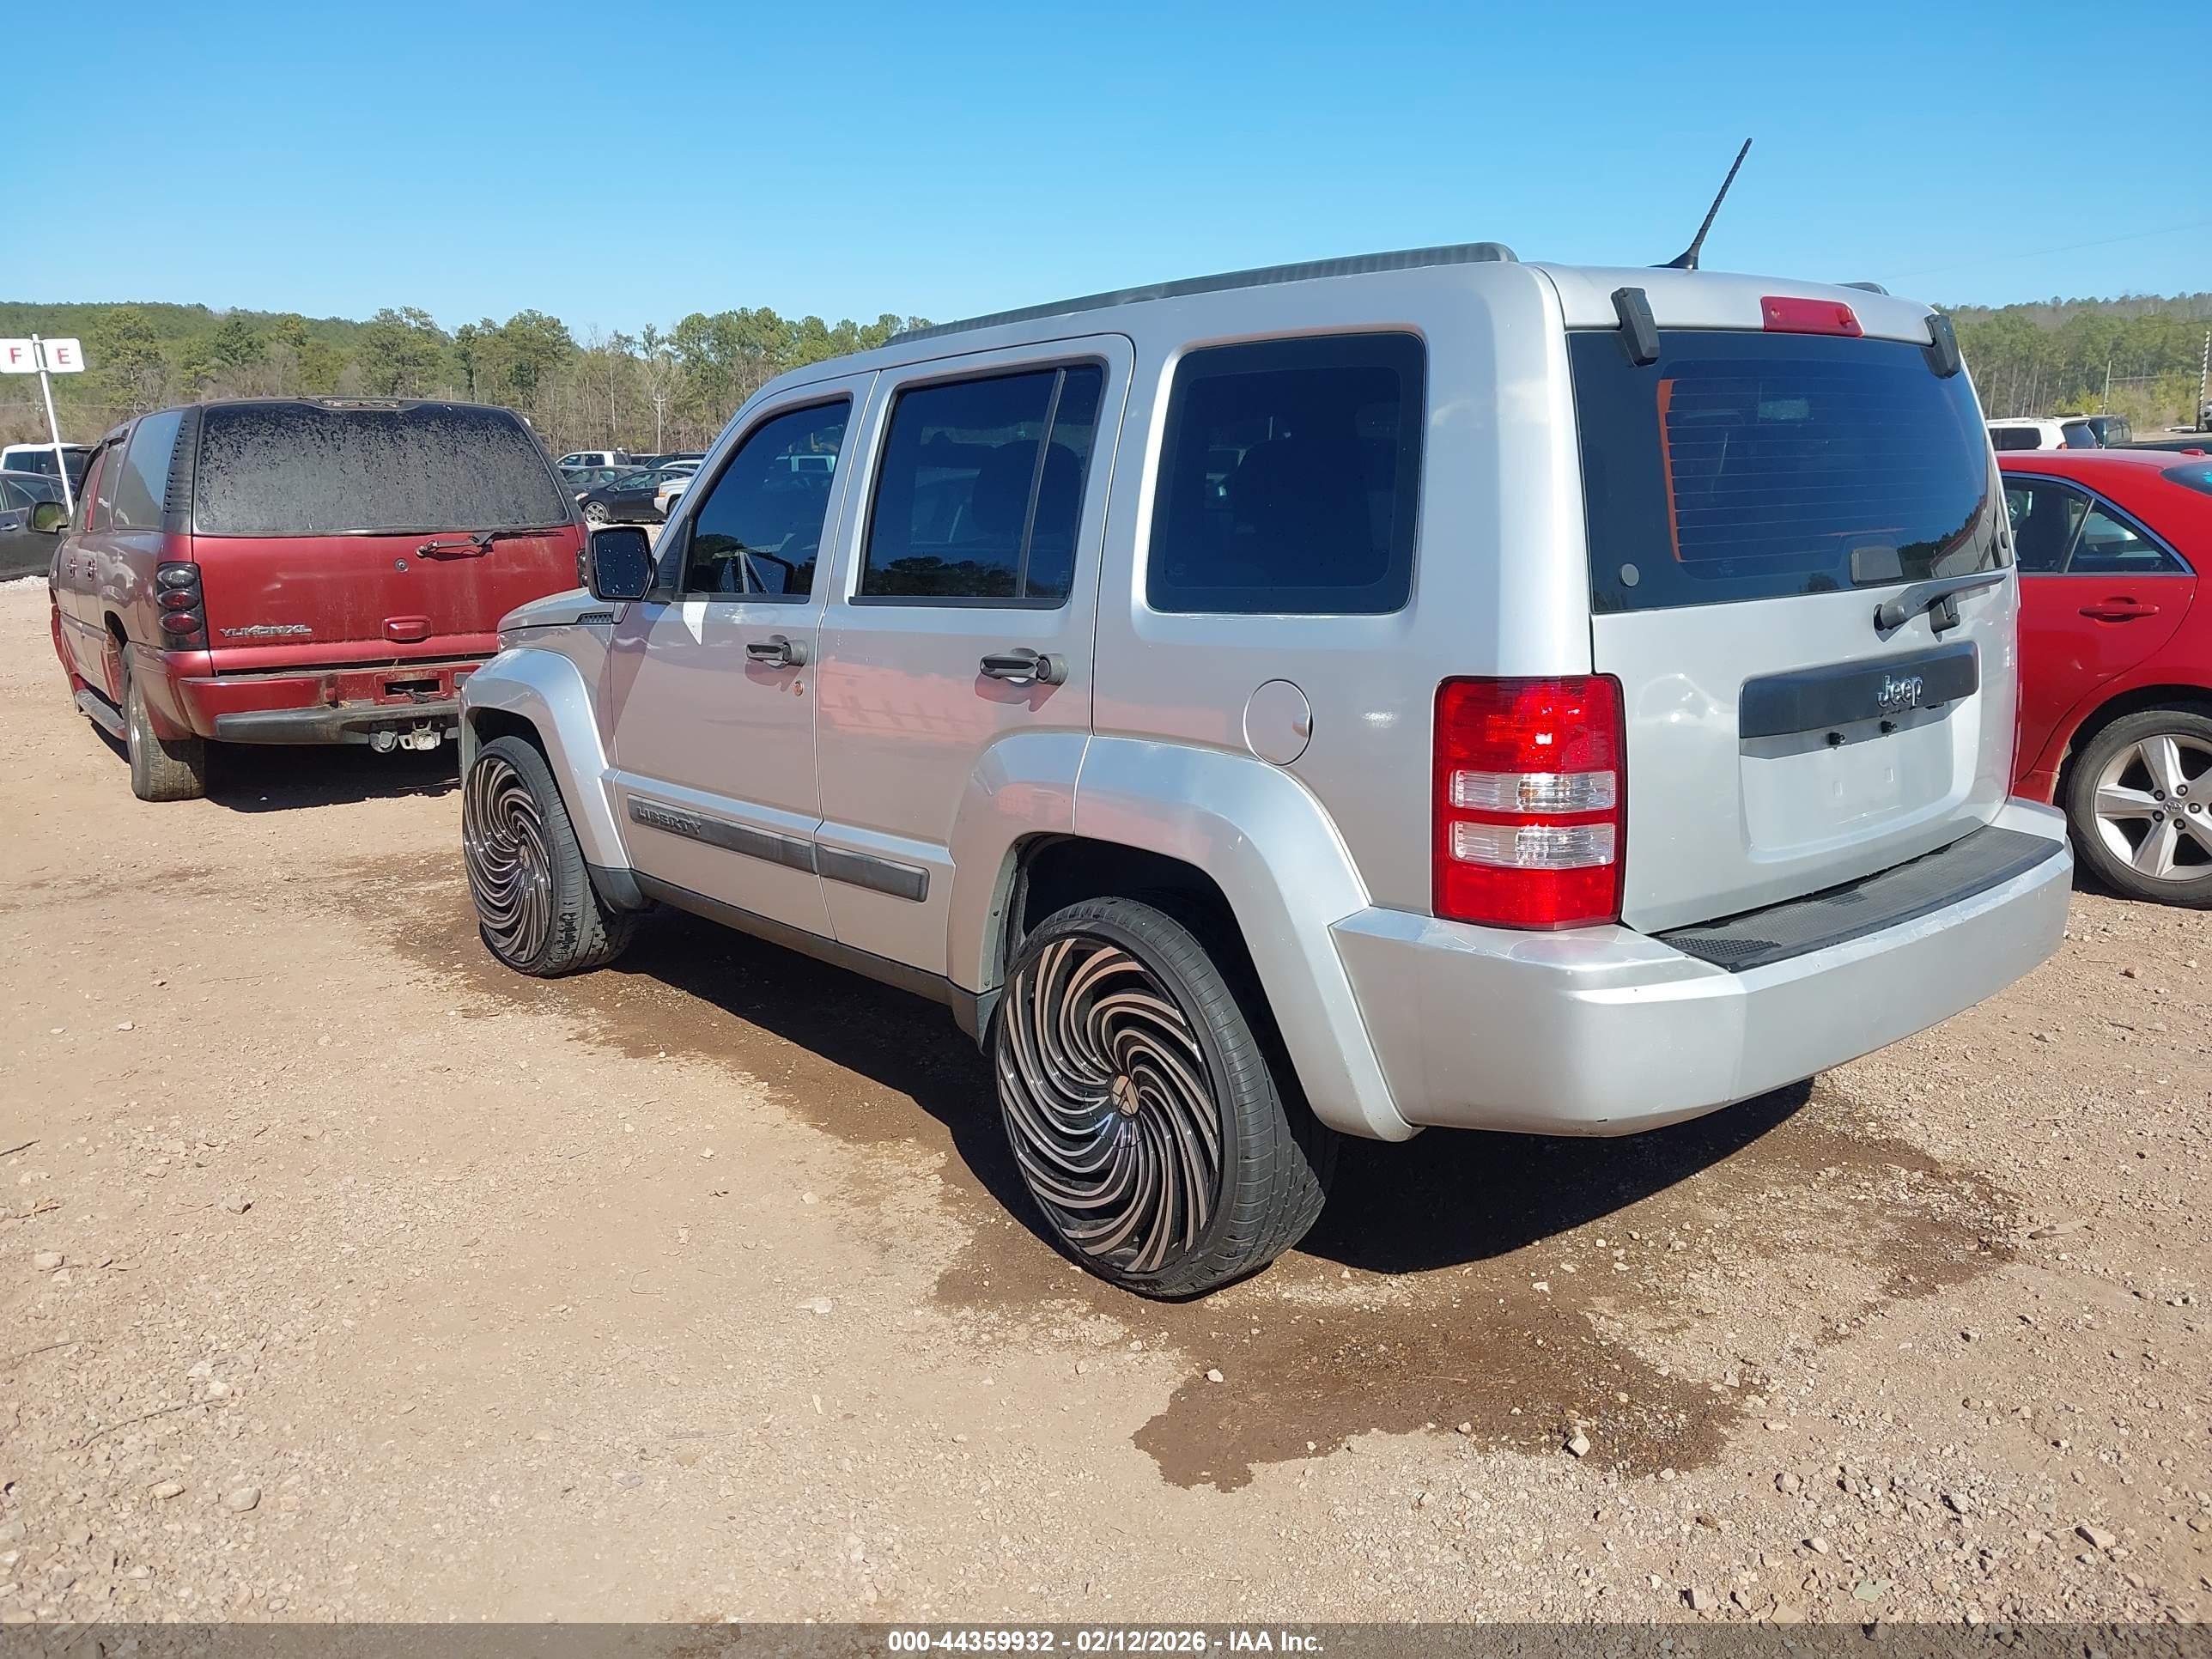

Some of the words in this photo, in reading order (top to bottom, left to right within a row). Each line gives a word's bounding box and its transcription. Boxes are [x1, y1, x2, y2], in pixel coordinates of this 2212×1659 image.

[9, 347, 21, 364] F
[56, 348, 71, 364] E
[1877, 675, 1923, 708] Jeep
[636, 805, 702, 835] LIBERTY
